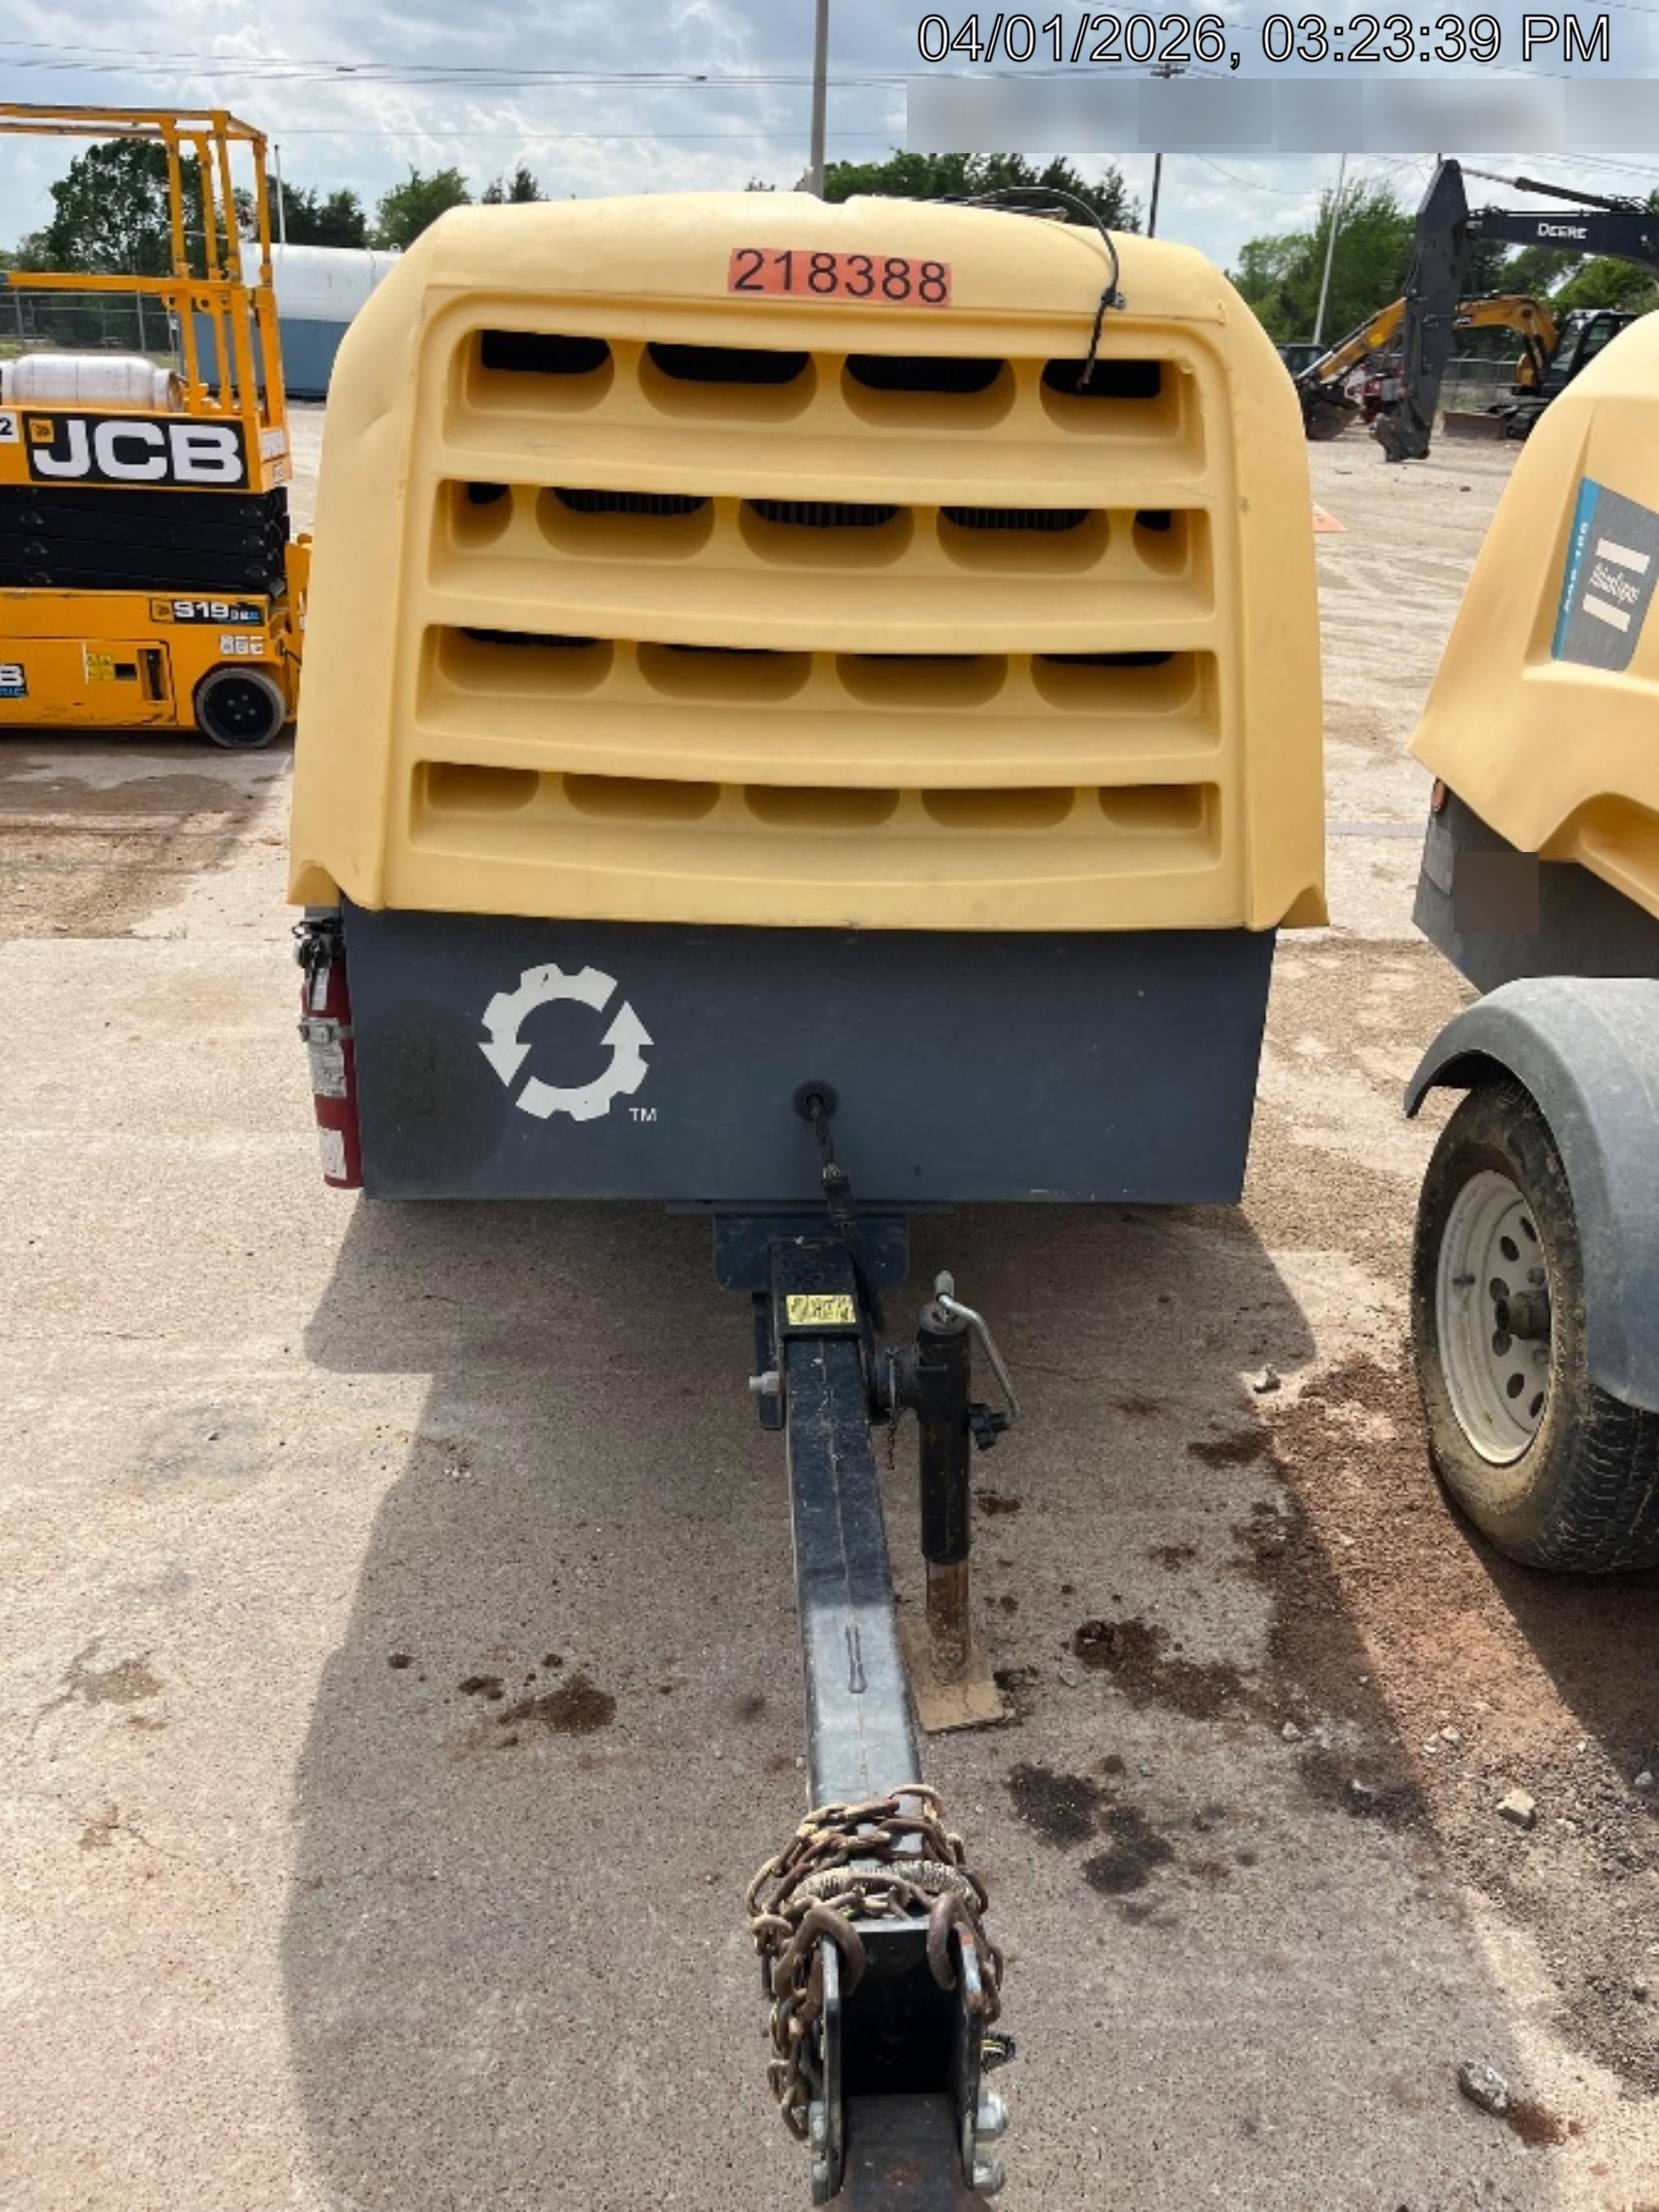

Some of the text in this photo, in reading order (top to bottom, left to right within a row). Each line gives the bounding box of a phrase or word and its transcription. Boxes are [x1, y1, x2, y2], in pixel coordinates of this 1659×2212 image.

[1538, 222, 1588, 239] DEERE
[733, 248, 948, 303] 218388
[32, 419, 244, 483] JCB
[628, 1107, 657, 1122] TM
